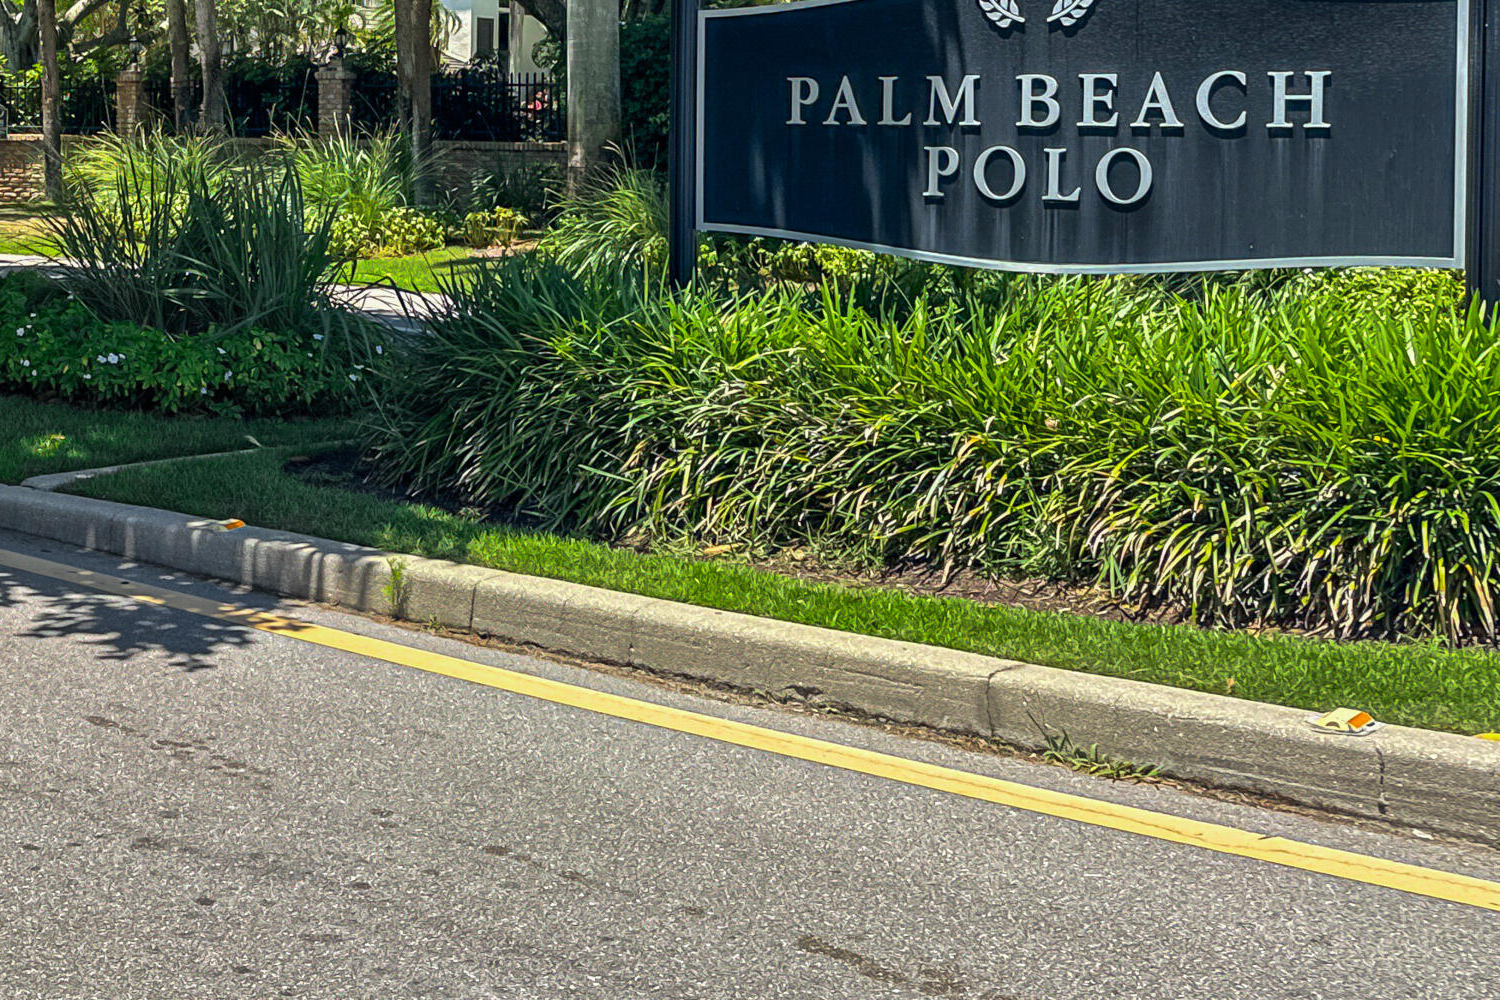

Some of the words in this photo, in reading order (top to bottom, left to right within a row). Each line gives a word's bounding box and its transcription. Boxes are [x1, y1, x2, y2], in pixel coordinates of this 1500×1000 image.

[786, 75, 981, 126] PALM
[1016, 70, 1332, 129] BEACH
[922, 146, 1153, 204] POLO
